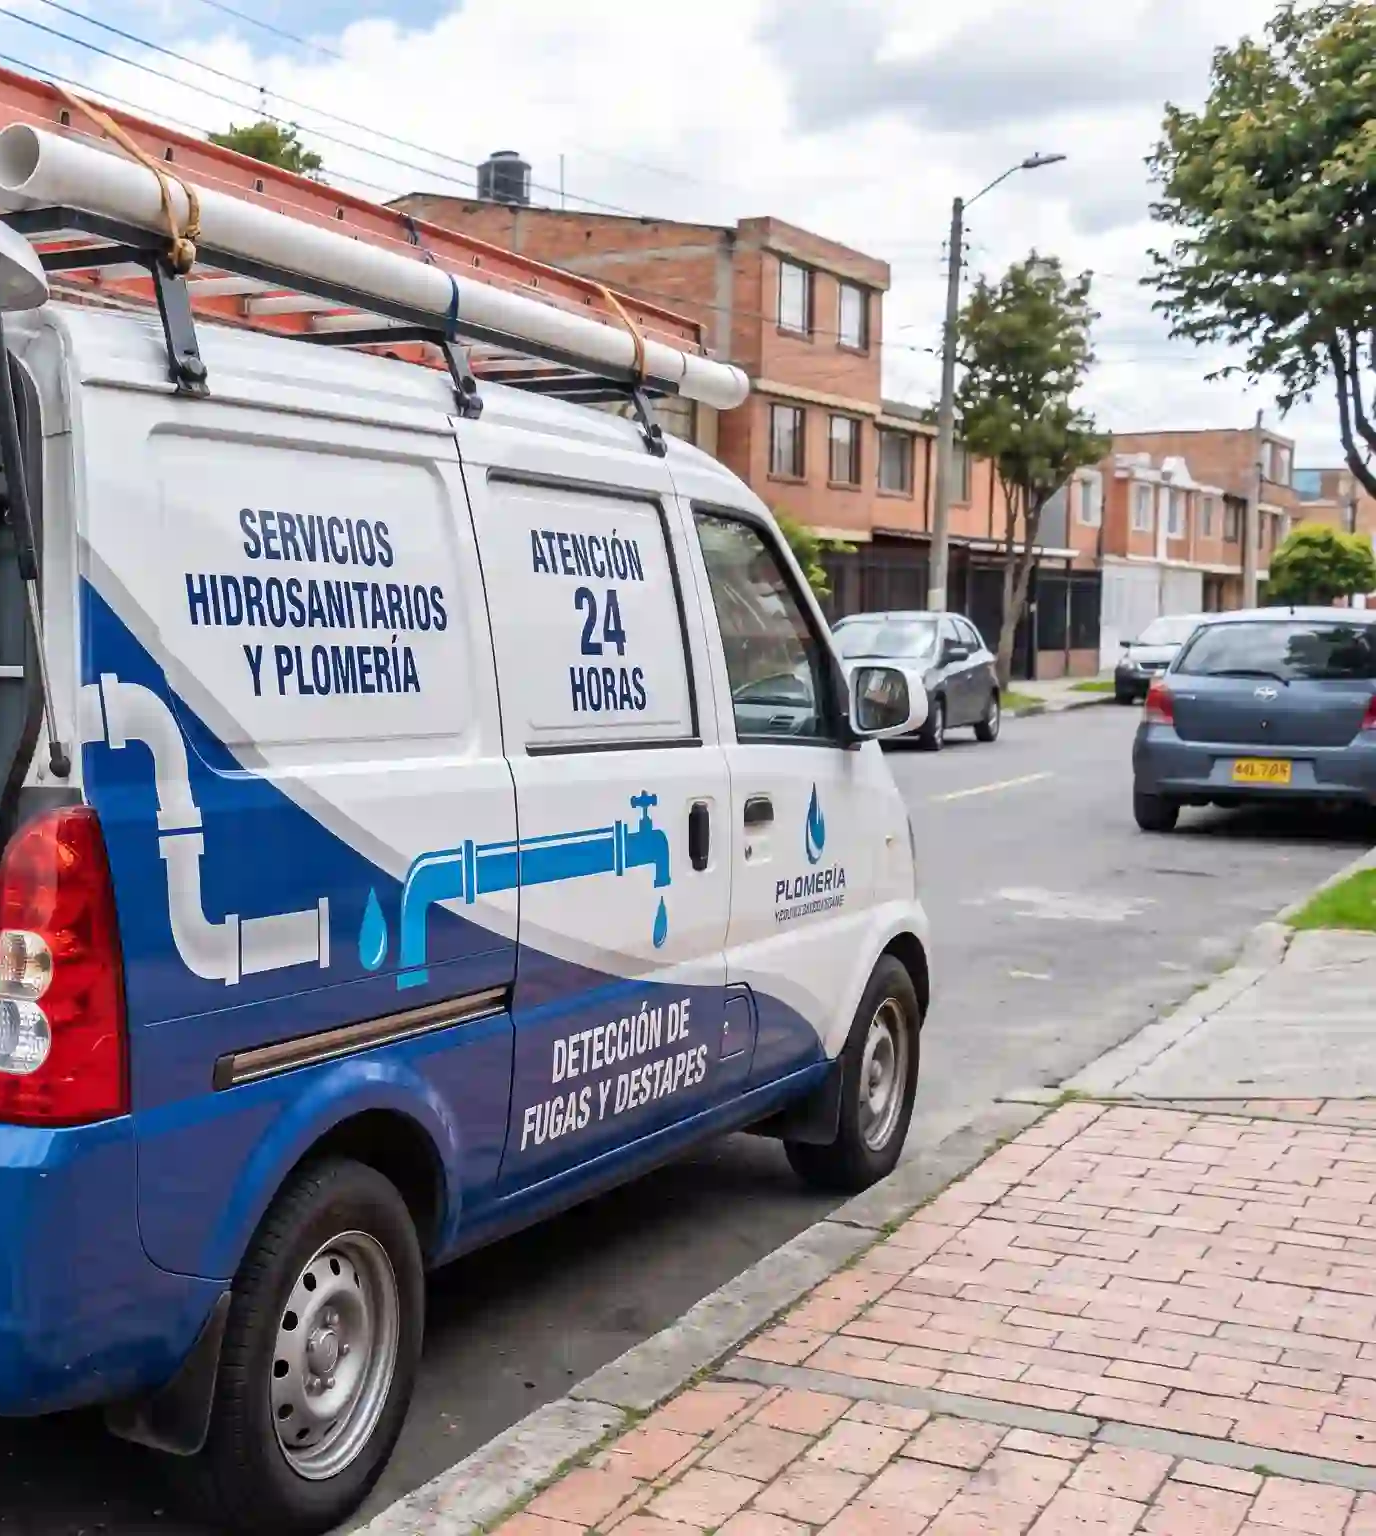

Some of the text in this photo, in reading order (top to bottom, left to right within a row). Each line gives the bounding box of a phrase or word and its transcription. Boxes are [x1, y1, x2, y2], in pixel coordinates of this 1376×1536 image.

[239, 508, 394, 568] SERVICIOS
[531, 528, 645, 582] ATENCIÓN
[184, 572, 448, 632] HIDROSANITARIOS
[573, 586, 627, 657] 24
[242, 633, 421, 697] Y PLOMERÍA
[569, 666, 647, 713] HORAS
[775, 863, 846, 903] PLOMERÍA
[552, 998, 692, 1084] DETECCIÓN DE
[520, 1044, 708, 1152] FUGAS Y DESTAPES
